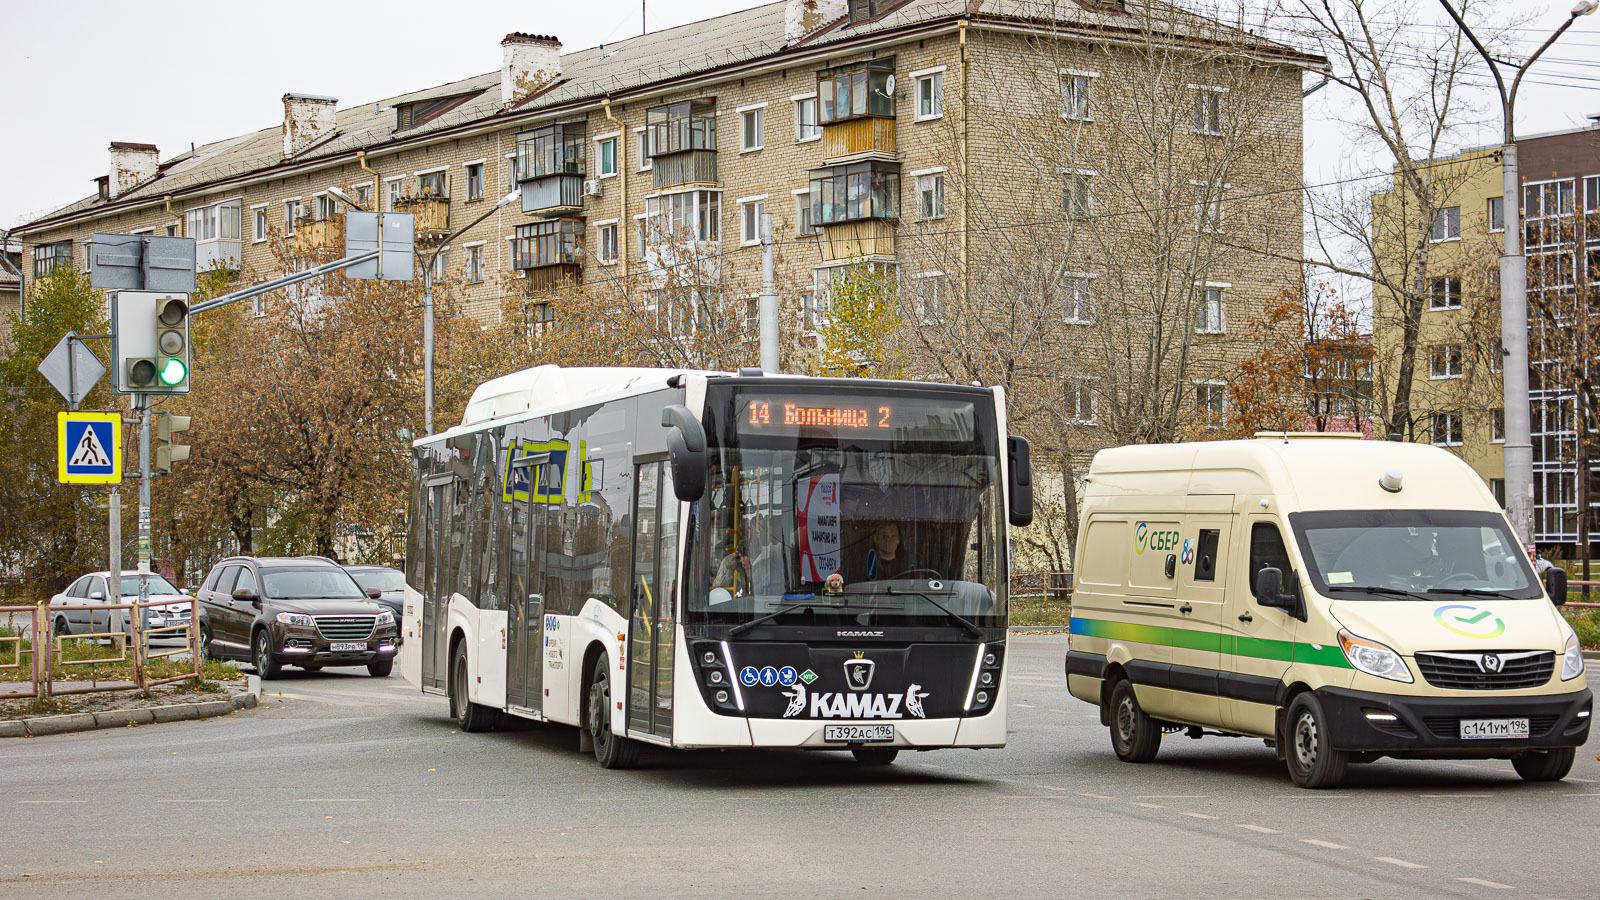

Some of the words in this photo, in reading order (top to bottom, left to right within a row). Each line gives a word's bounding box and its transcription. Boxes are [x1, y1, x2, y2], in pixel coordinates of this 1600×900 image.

[749, 402, 770, 424] 14
[784, 403, 868, 427] Больница
[878, 406, 890, 427] 2
[1150, 531, 1180, 550] СБЕР
[810, 692, 903, 718] KAMAZ
[829, 726, 872, 739] Т392АС
[874, 726, 892, 735] 196
[1464, 722, 1508, 735] С141УМ
[1509, 720, 1527, 729] 196
